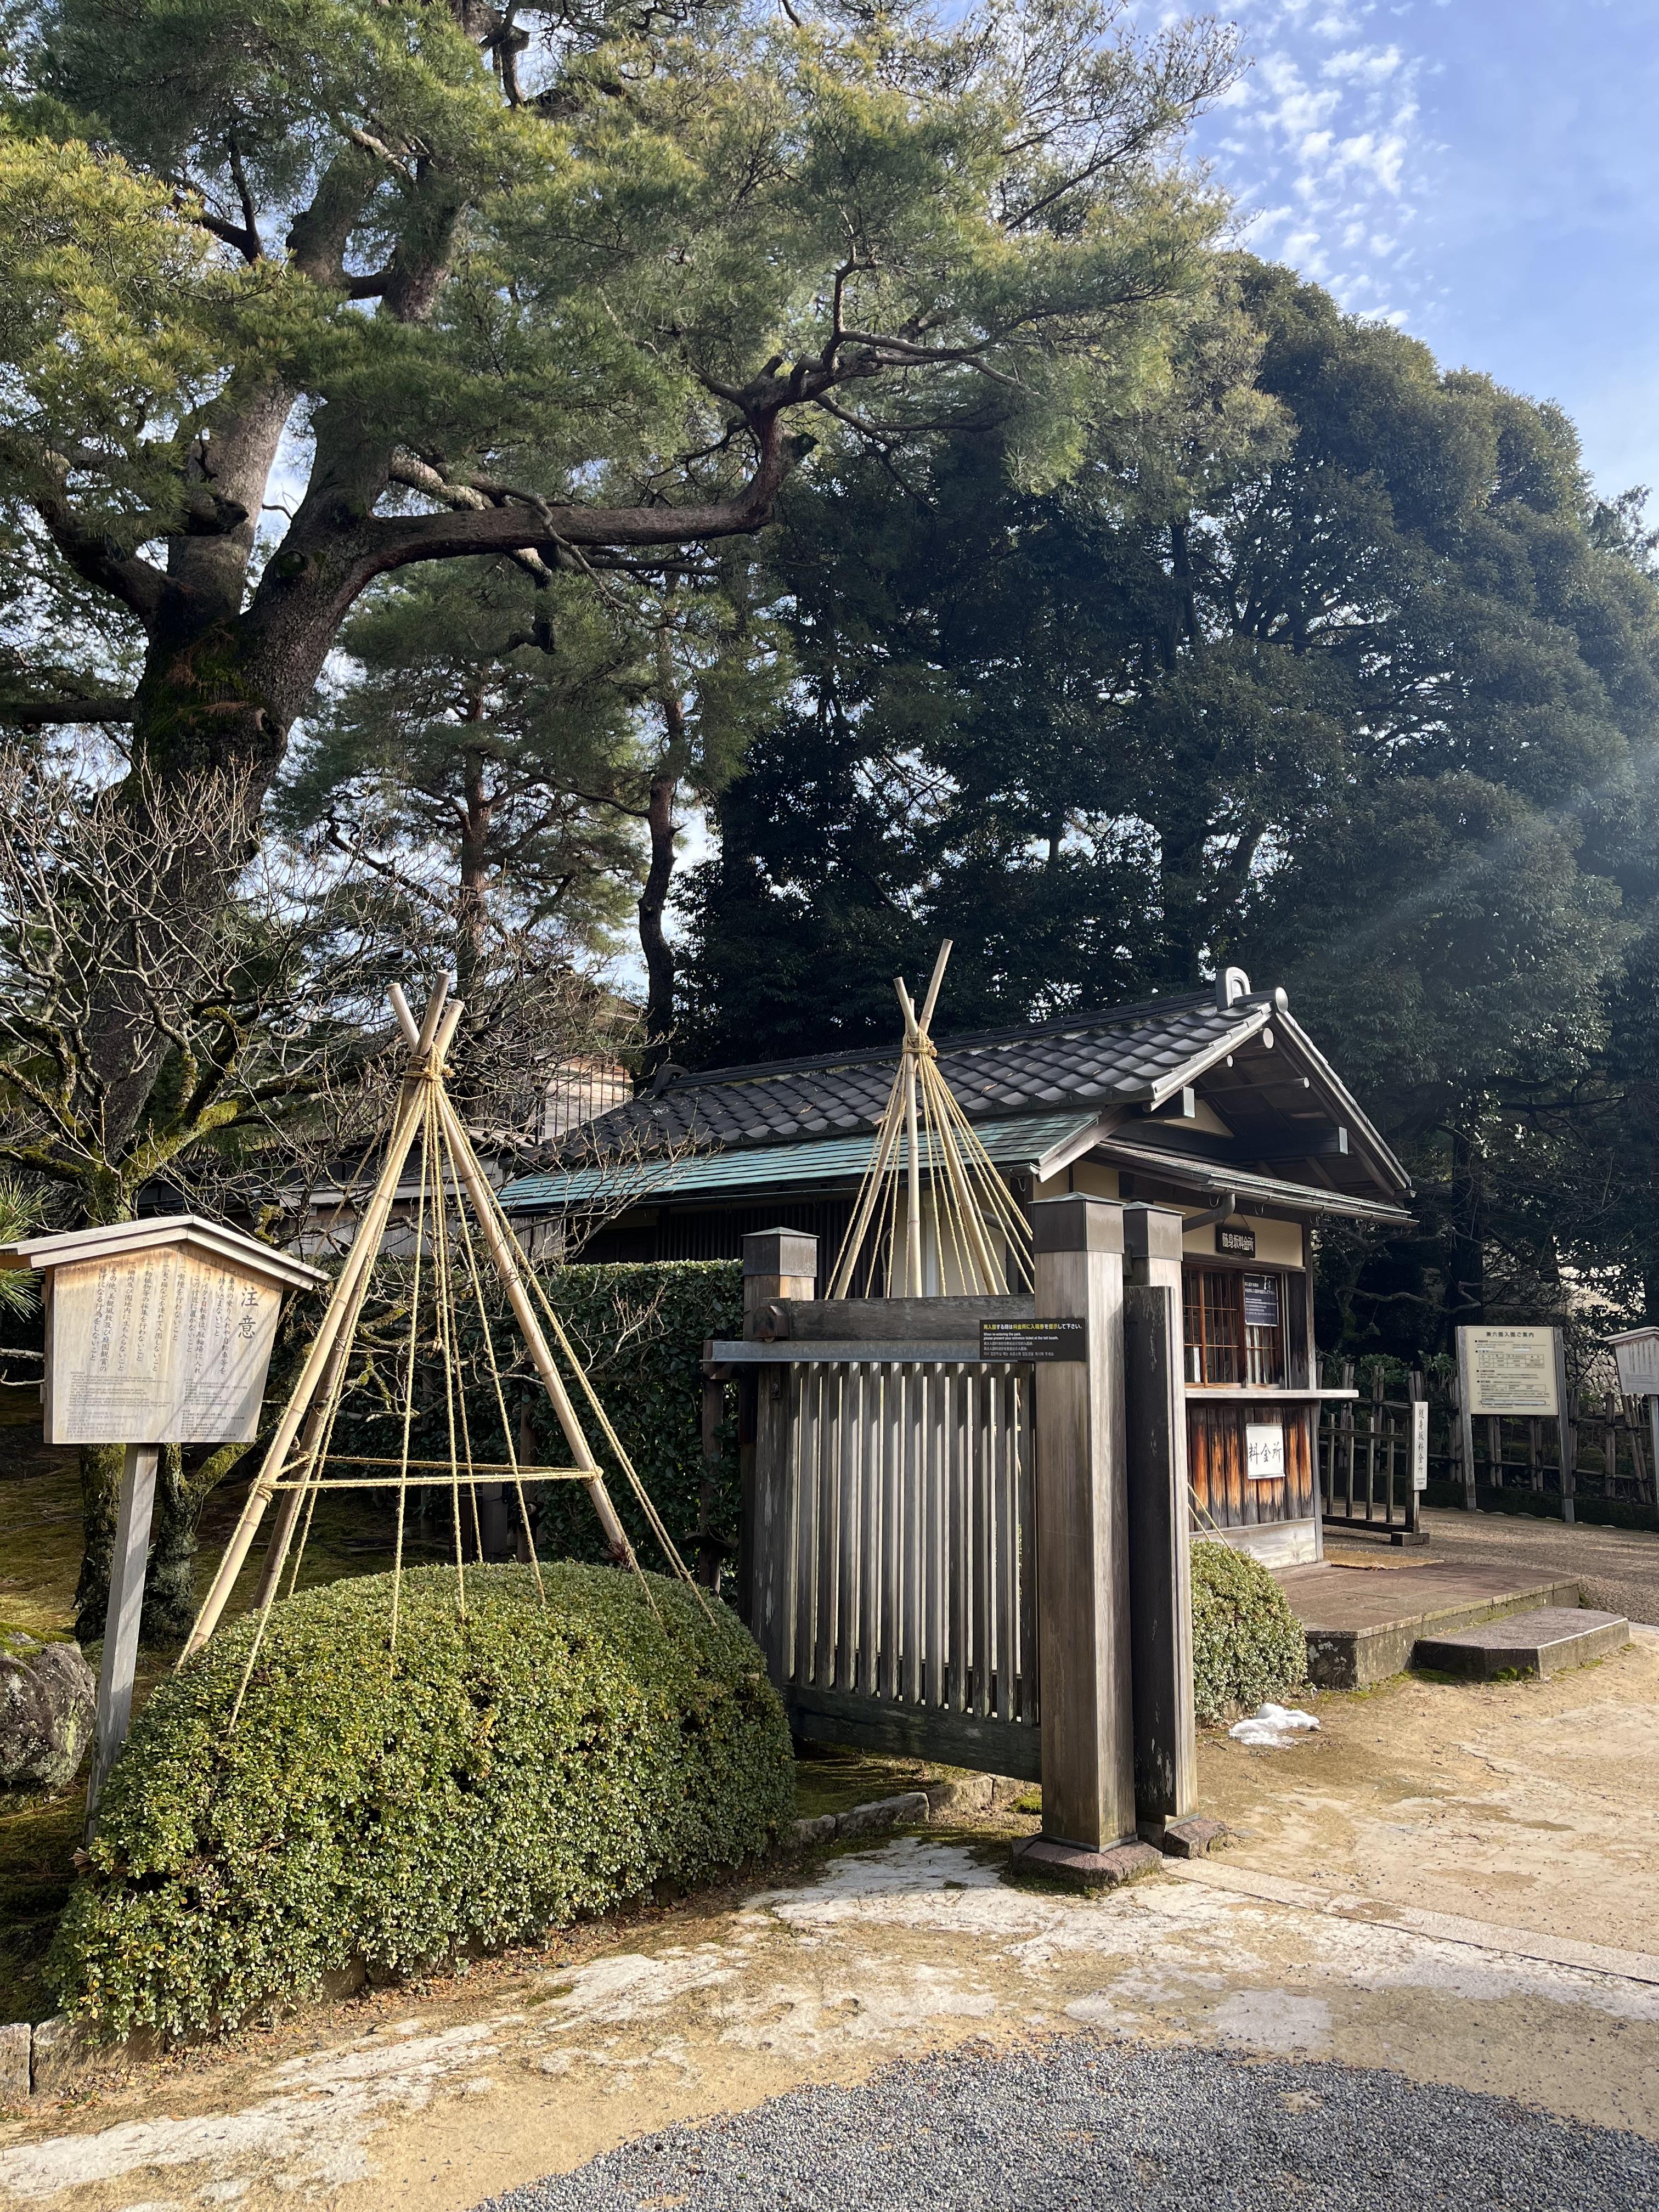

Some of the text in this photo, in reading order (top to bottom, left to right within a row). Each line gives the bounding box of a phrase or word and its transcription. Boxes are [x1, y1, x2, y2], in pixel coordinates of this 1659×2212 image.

[187, 1276, 199, 1352] この付近に置かないこと
[214, 1277, 225, 1336] 持ち込まないこと
[238, 1286, 259, 1339] 注意
[1249, 1441, 1282, 1465] 料金所
